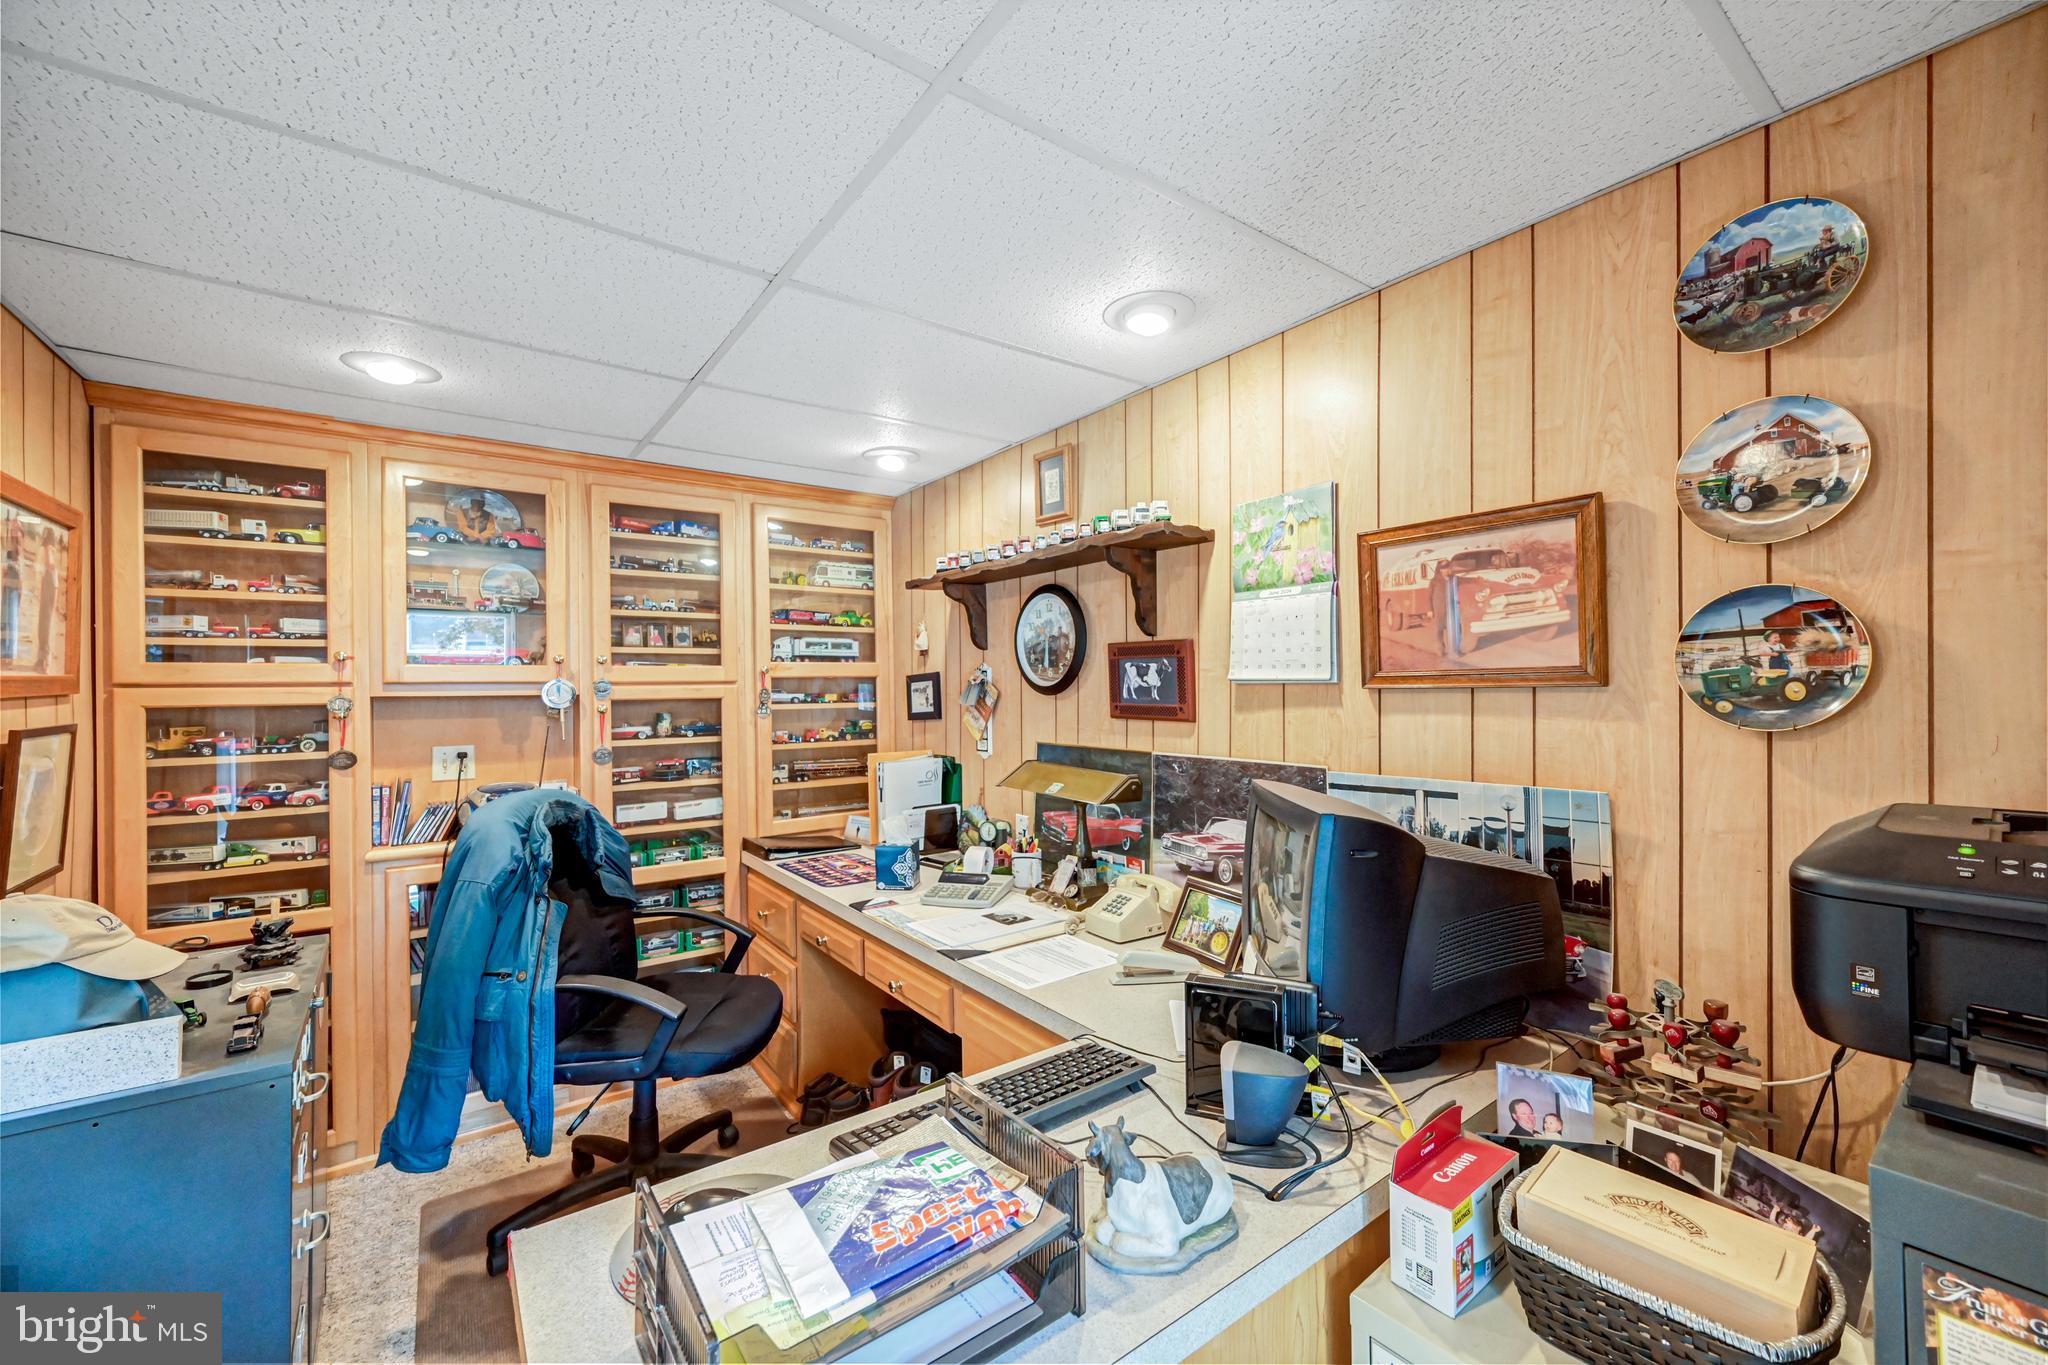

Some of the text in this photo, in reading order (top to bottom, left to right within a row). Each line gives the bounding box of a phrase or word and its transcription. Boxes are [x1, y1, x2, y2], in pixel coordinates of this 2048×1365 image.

[1046, 603, 1053, 612] 12
[1860, 986, 1880, 996] FINE
[1420, 1142, 1435, 1157] Canon
[1432, 1152, 1478, 1183] Canon
[870, 1183, 988, 1253] Sport
[1454, 1209, 1471, 1228] SAVINGS
[1584, 1195, 1610, 1209] Where
[1613, 1208, 1640, 1221] simple
[1644, 1221, 1686, 1241] goodness
[1615, 1195, 1647, 1206] LAND
[1669, 1210, 1704, 1236] LAKES
[1926, 1276, 2004, 1319] Fruit
[1970, 1310, 2030, 1339] Closer
